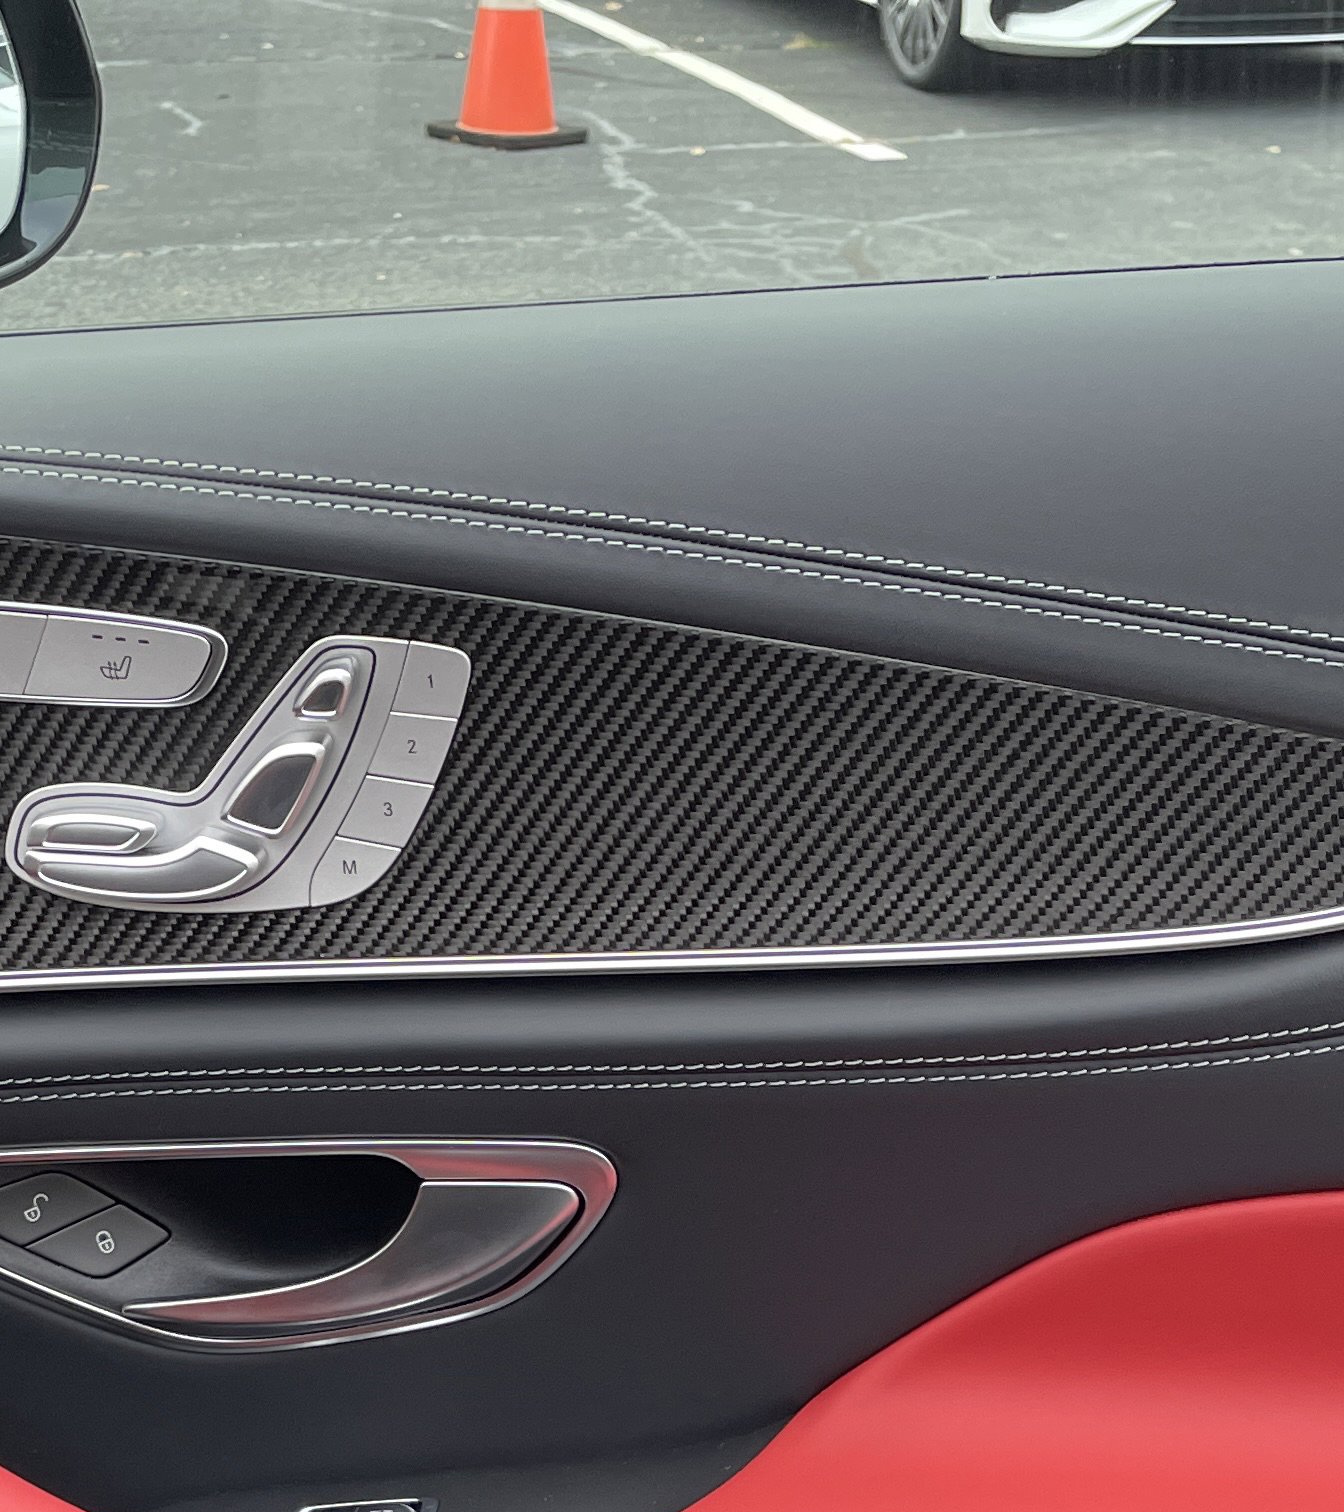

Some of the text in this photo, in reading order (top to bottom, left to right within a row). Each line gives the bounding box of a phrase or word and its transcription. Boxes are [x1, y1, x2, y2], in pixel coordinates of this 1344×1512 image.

[426, 673, 434, 689] 1
[406, 739, 418, 755] 2
[383, 802, 393, 818] 3
[343, 859, 356, 875] M
